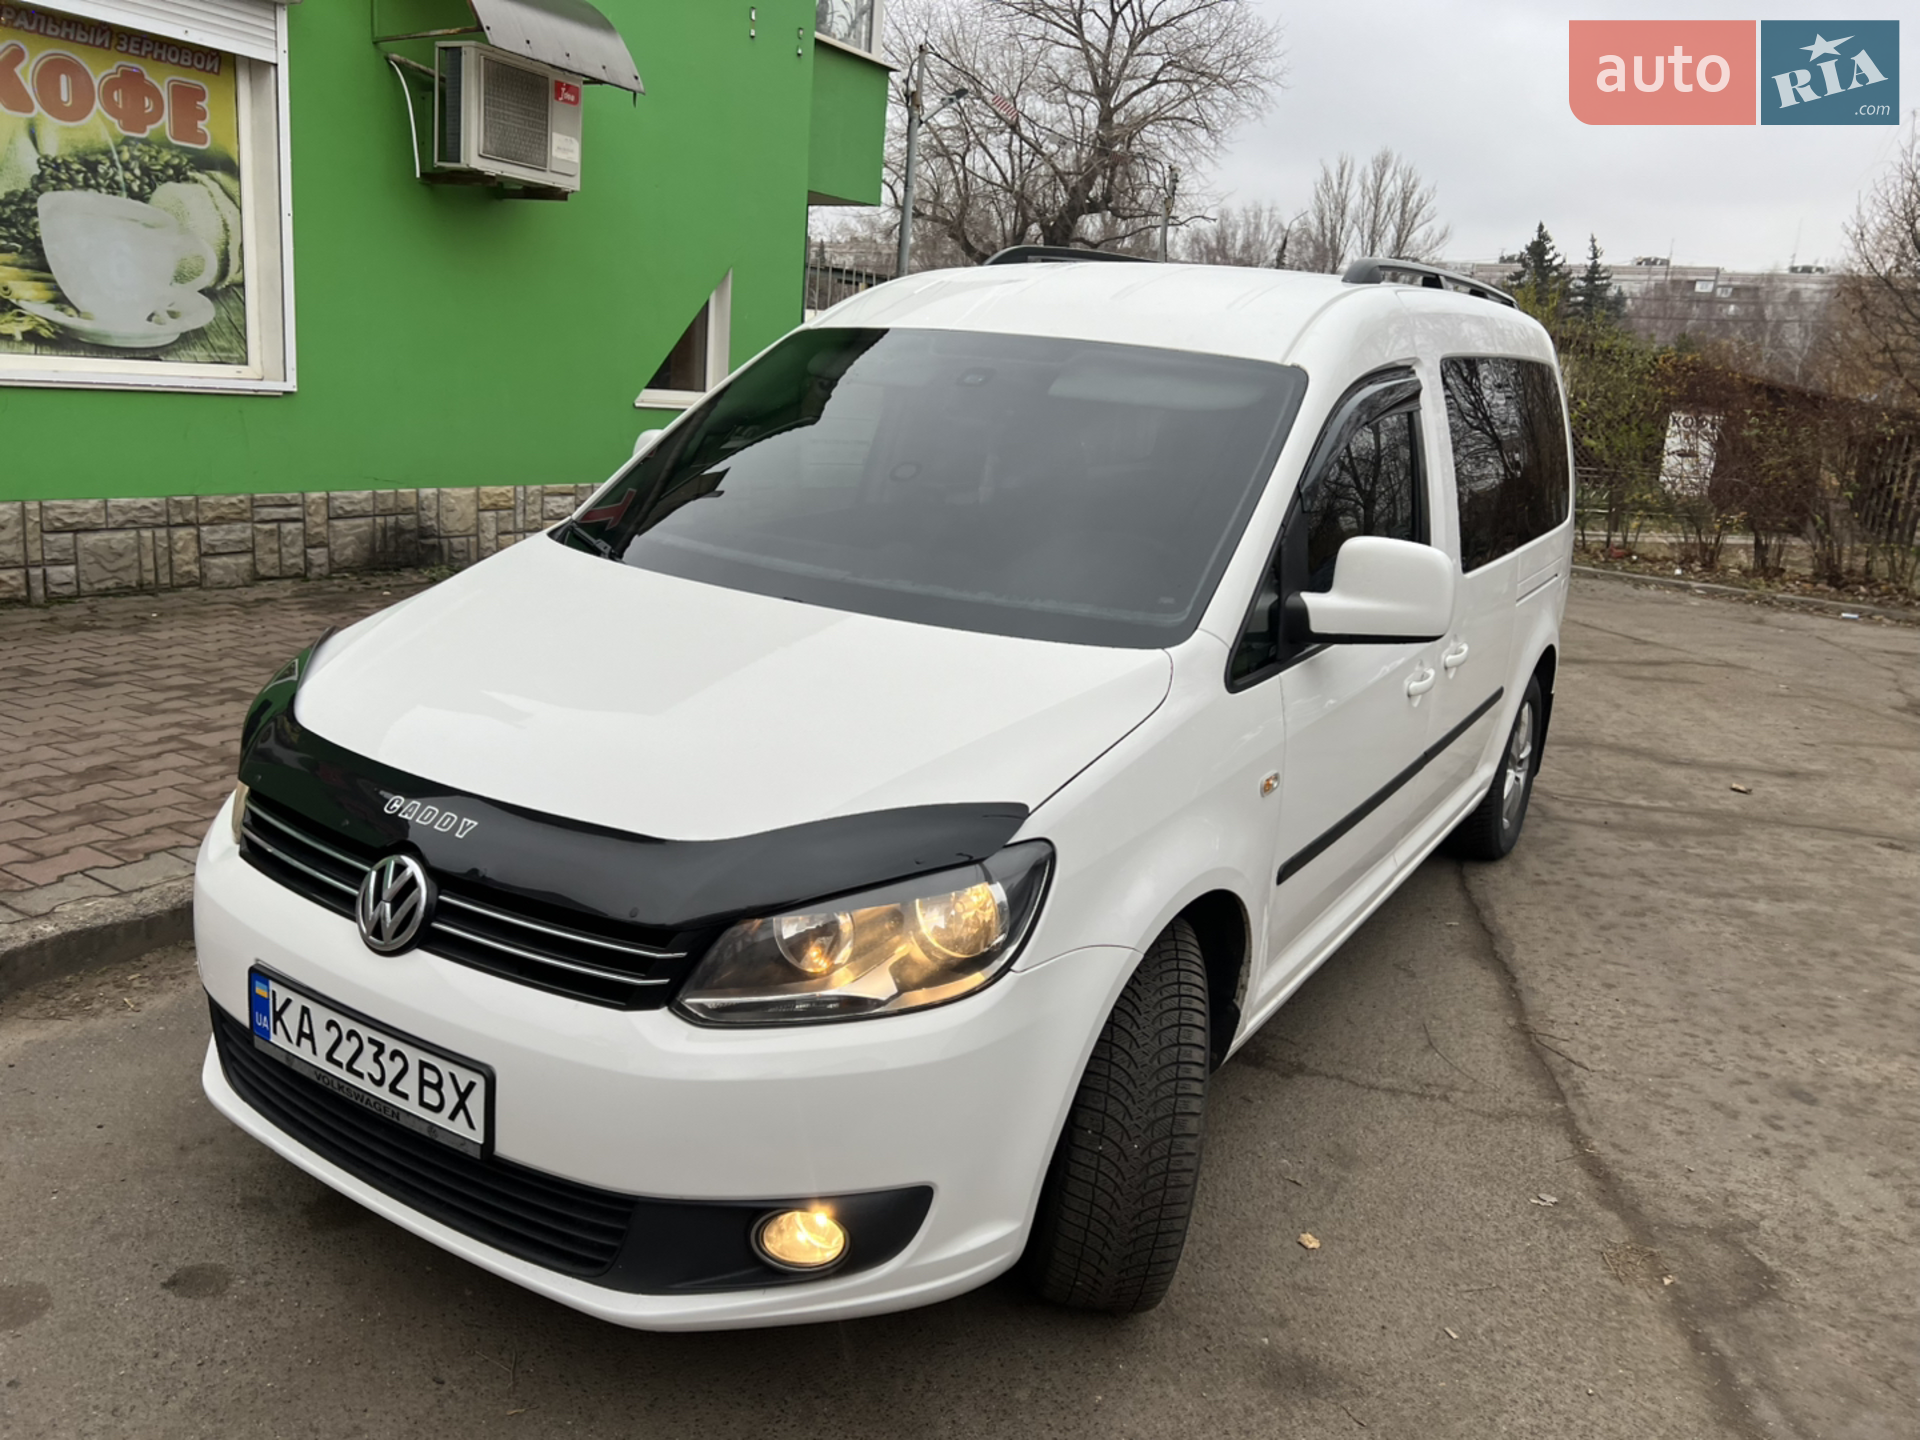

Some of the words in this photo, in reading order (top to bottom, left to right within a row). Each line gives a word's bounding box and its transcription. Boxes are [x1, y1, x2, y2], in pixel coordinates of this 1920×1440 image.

[116, 33, 221, 75] ЗЕРНОВОЙ
[0, 42, 209, 148] КОФЕ
[384, 796, 478, 838] CADDY
[256, 1012, 269, 1031] UA
[314, 1070, 400, 1121] VOLKSWAGEN
